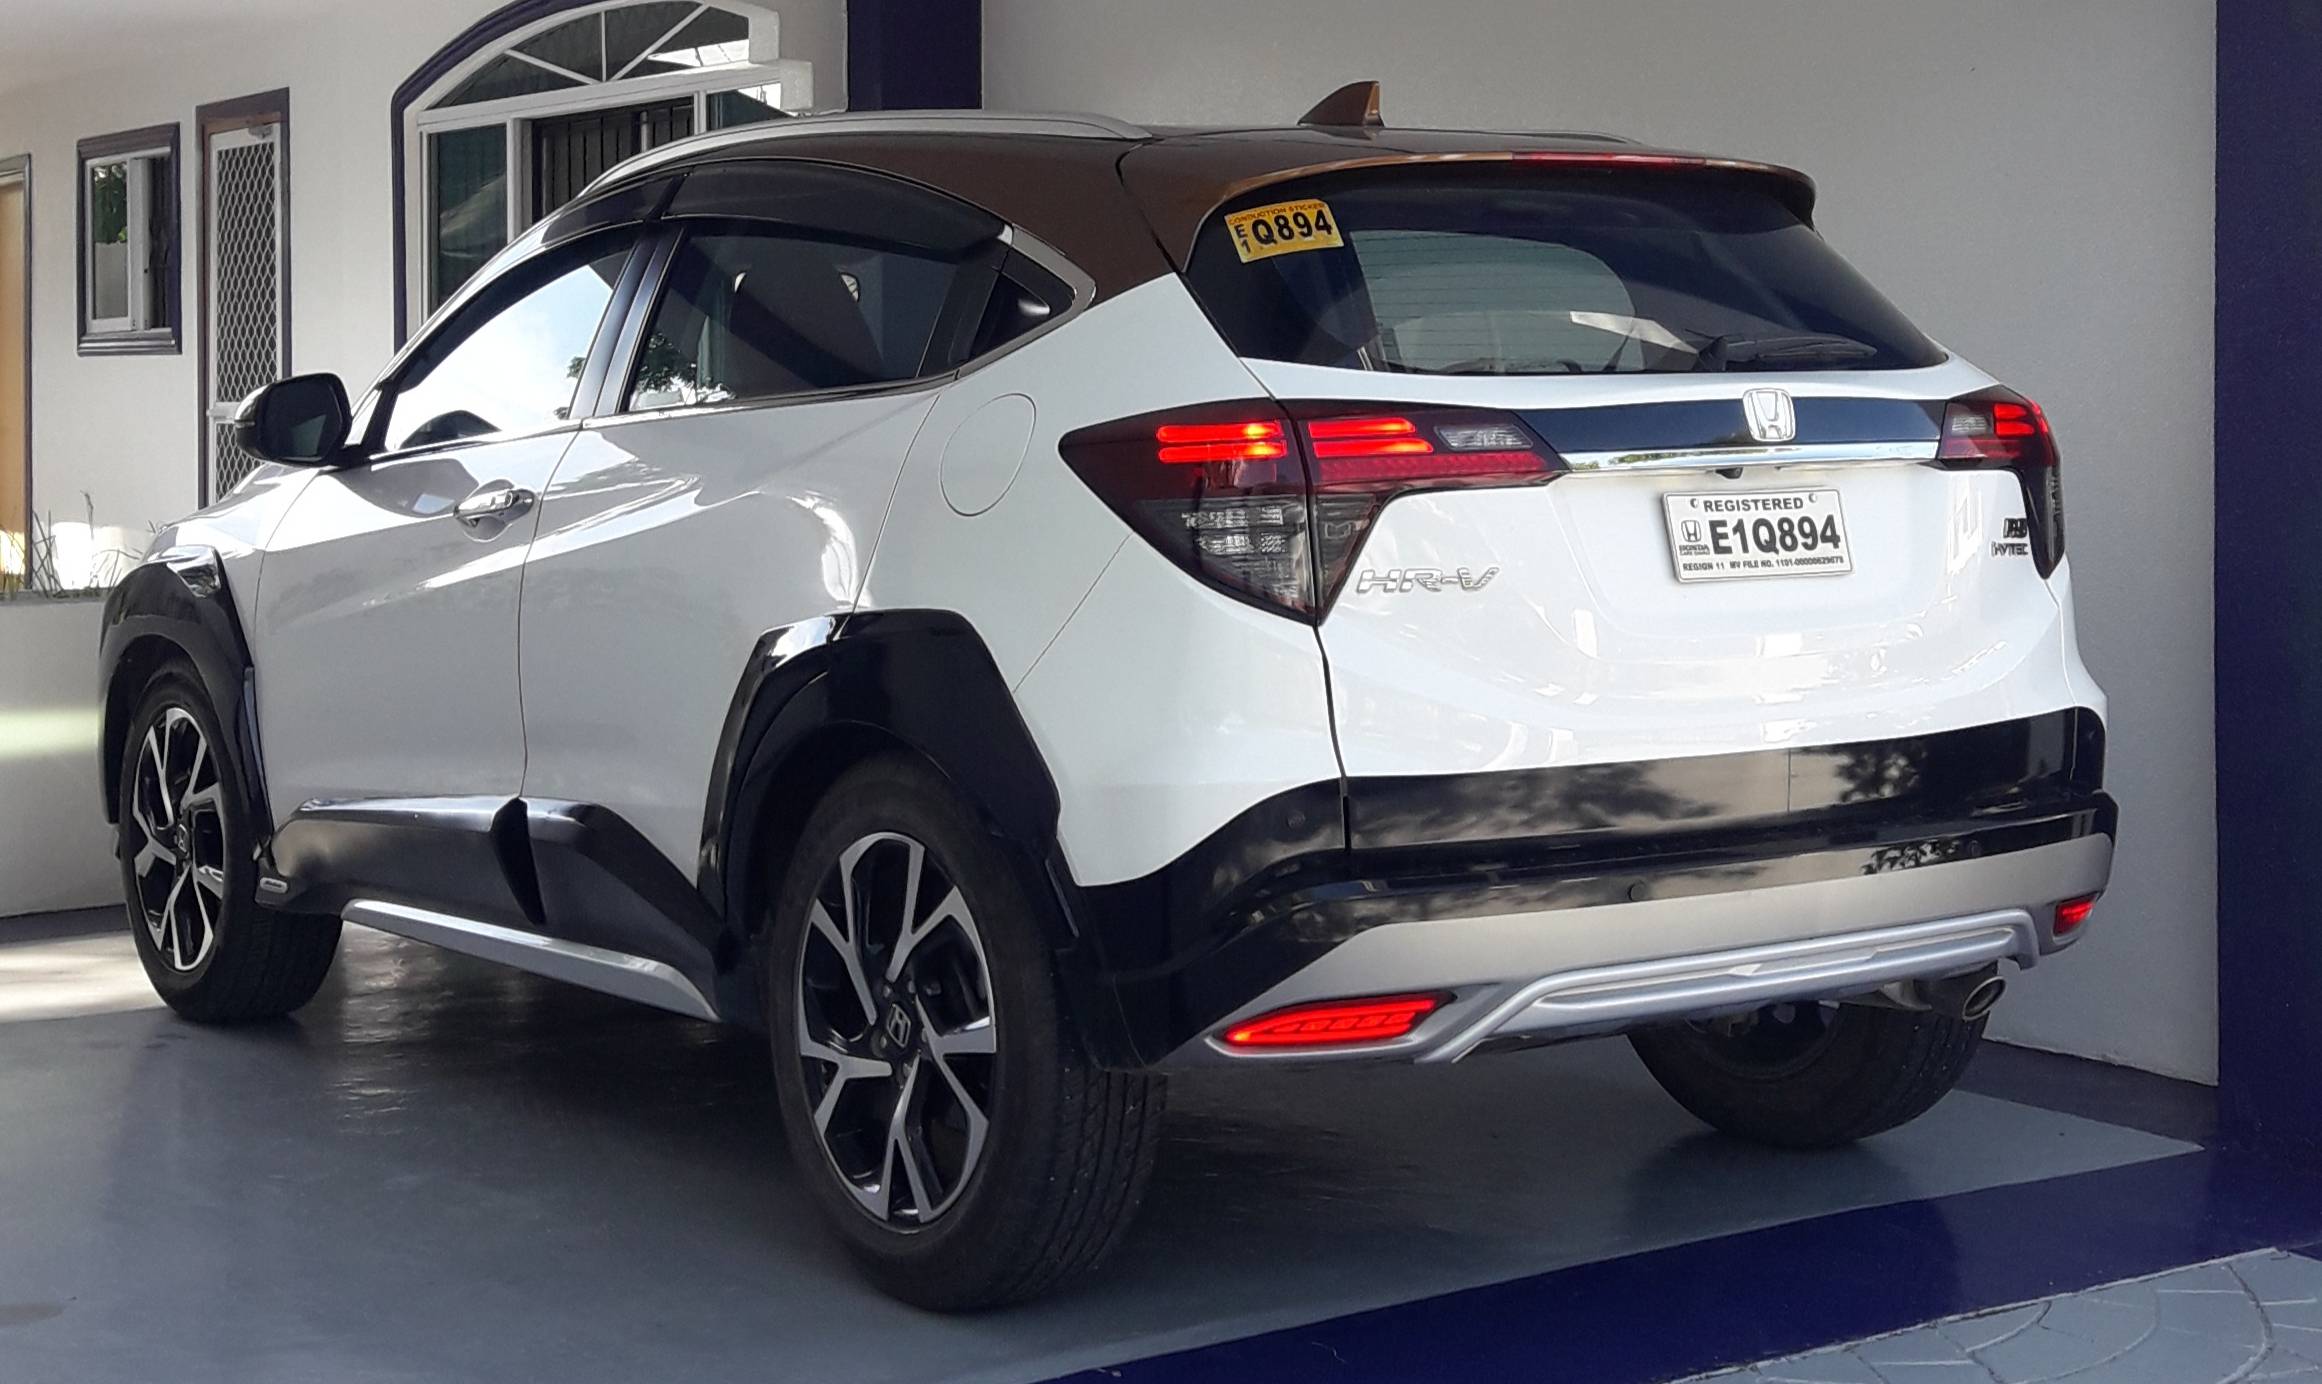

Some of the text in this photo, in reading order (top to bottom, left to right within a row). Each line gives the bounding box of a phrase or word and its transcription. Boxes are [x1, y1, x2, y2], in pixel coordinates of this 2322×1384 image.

[1251, 209, 1332, 245] Q894
[1703, 497, 1804, 512] REGISTERED
[1709, 514, 1841, 555] E1Q894
[1679, 544, 1710, 552] HONDA
[1682, 562, 1714, 571] REGION
[1716, 561, 1725, 570] 11
[1742, 559, 1759, 569] FILE
[1356, 566, 1500, 594] HR-V
